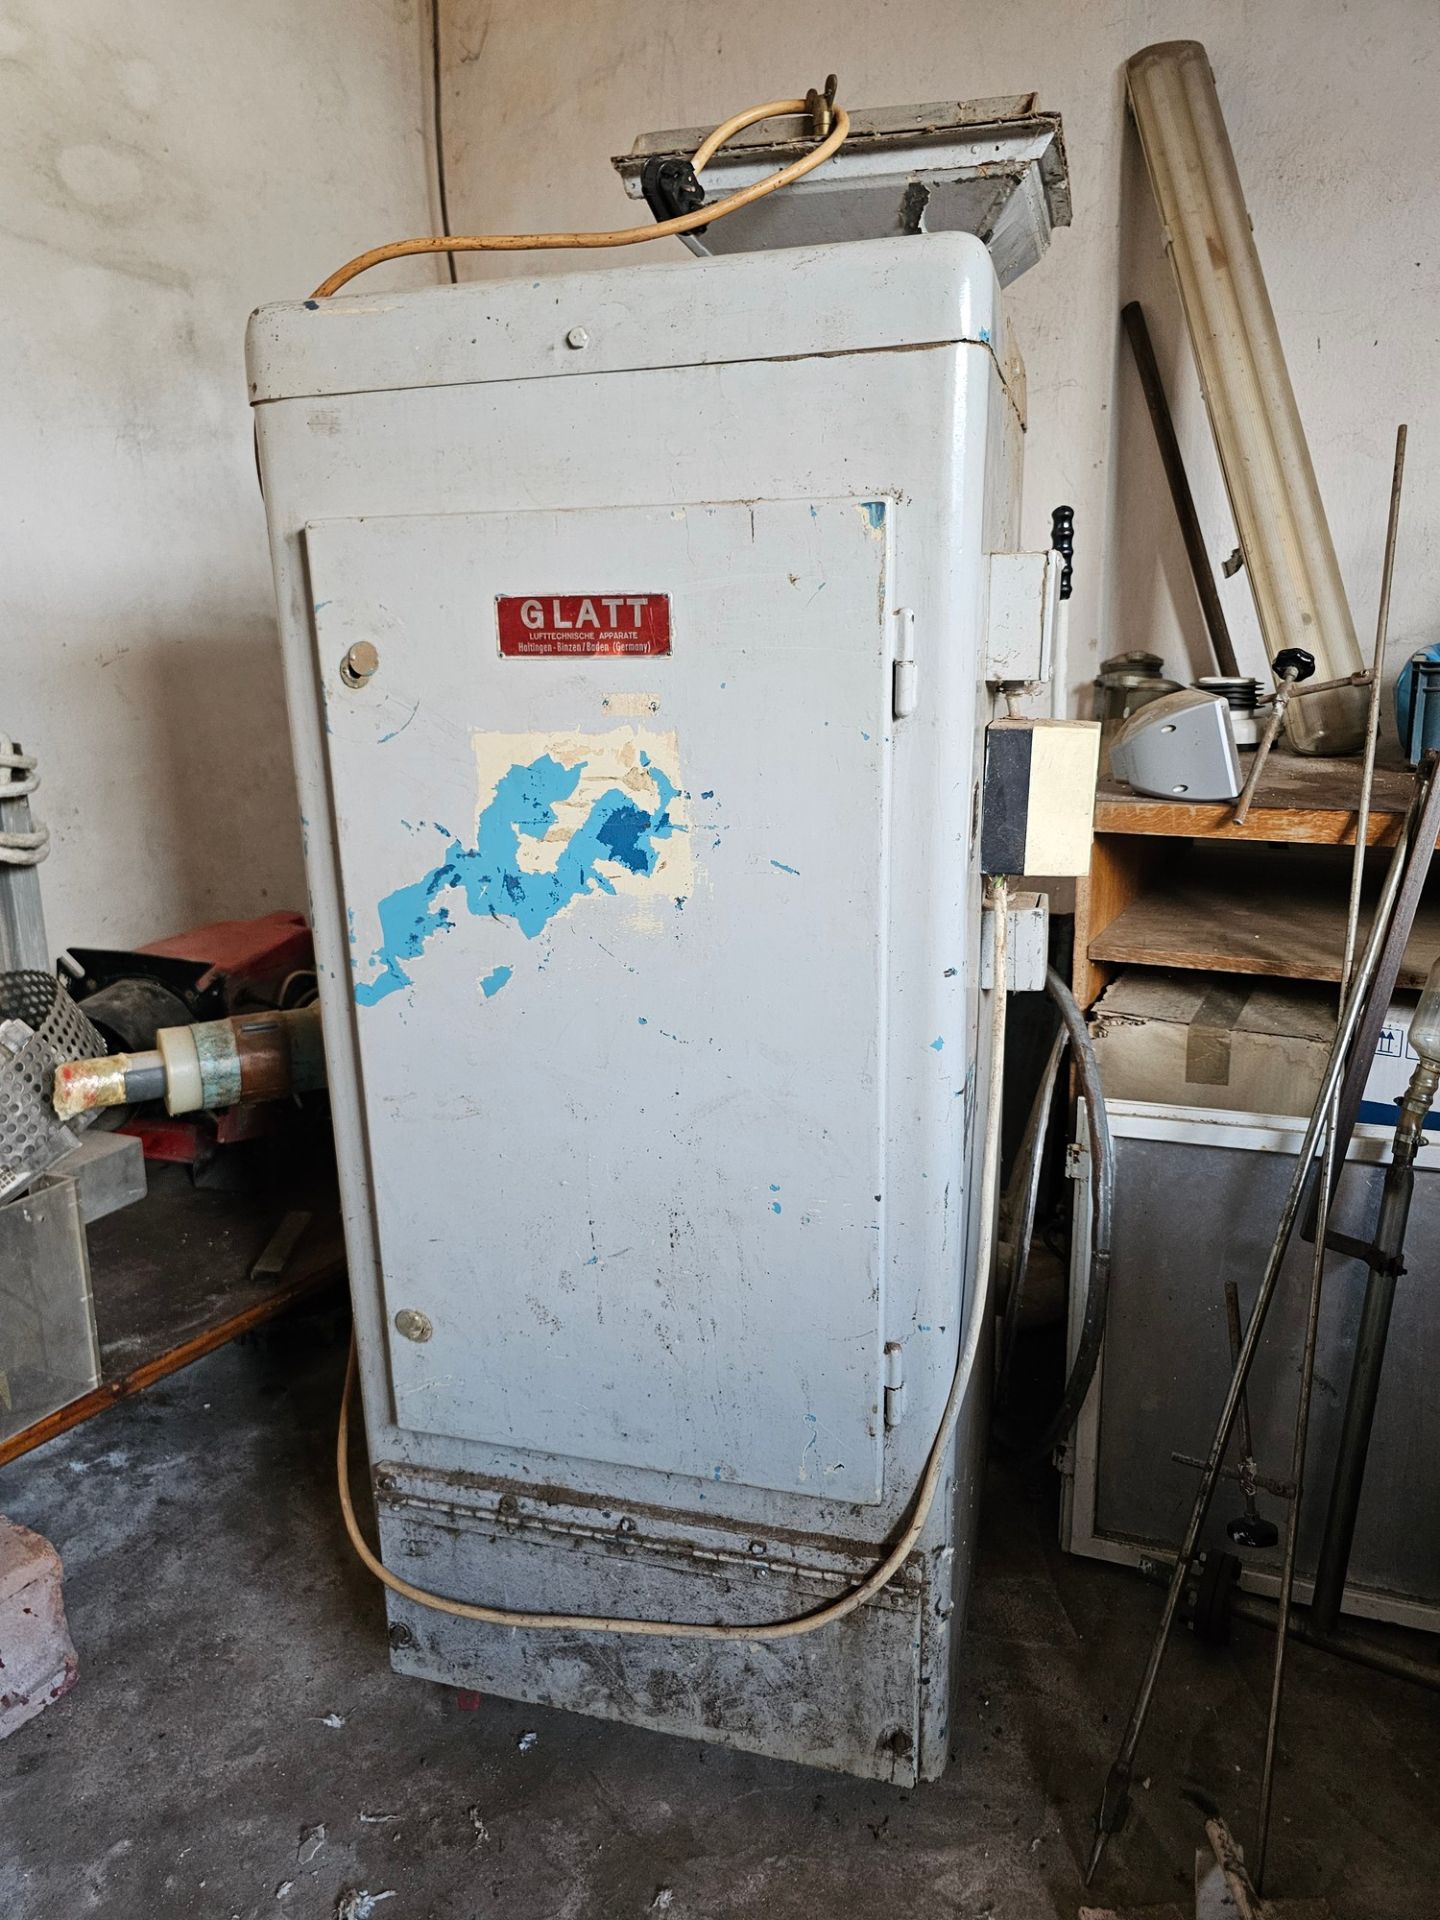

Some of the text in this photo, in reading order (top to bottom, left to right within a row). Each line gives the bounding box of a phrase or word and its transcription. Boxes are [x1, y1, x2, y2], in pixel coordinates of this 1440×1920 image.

[520, 598, 649, 629] GLATT
[529, 631, 638, 640] LUFTTECHNISCHE APPARATE
[612, 641, 651, 654] (Germany)
